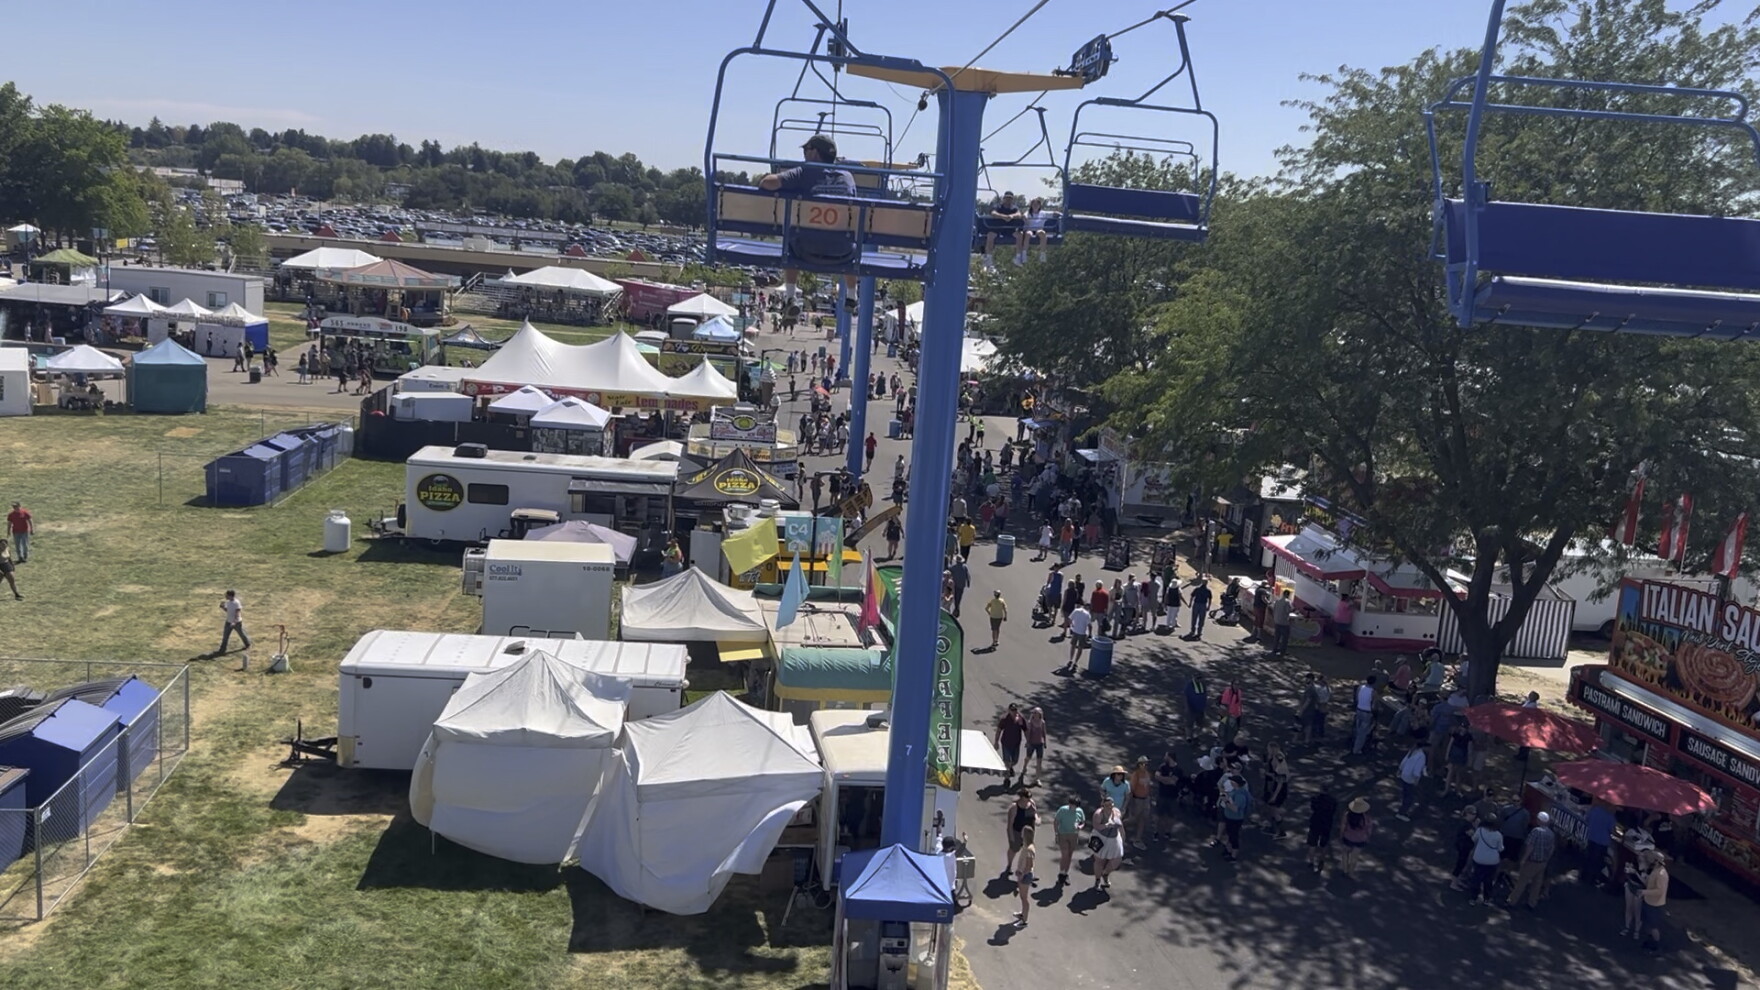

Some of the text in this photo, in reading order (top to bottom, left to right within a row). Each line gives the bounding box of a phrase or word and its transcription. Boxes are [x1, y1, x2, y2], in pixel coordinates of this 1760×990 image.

[809, 207, 838, 226] 20
[420, 491, 461, 502] PIZZA
[788, 523, 809, 536] C4
[1642, 583, 1717, 634] ITALIAN
[1583, 685, 1667, 738] PASTRAMI SANDWICH
[905, 744, 913, 756] 7
[1687, 737, 1728, 768] SAUSAGE
